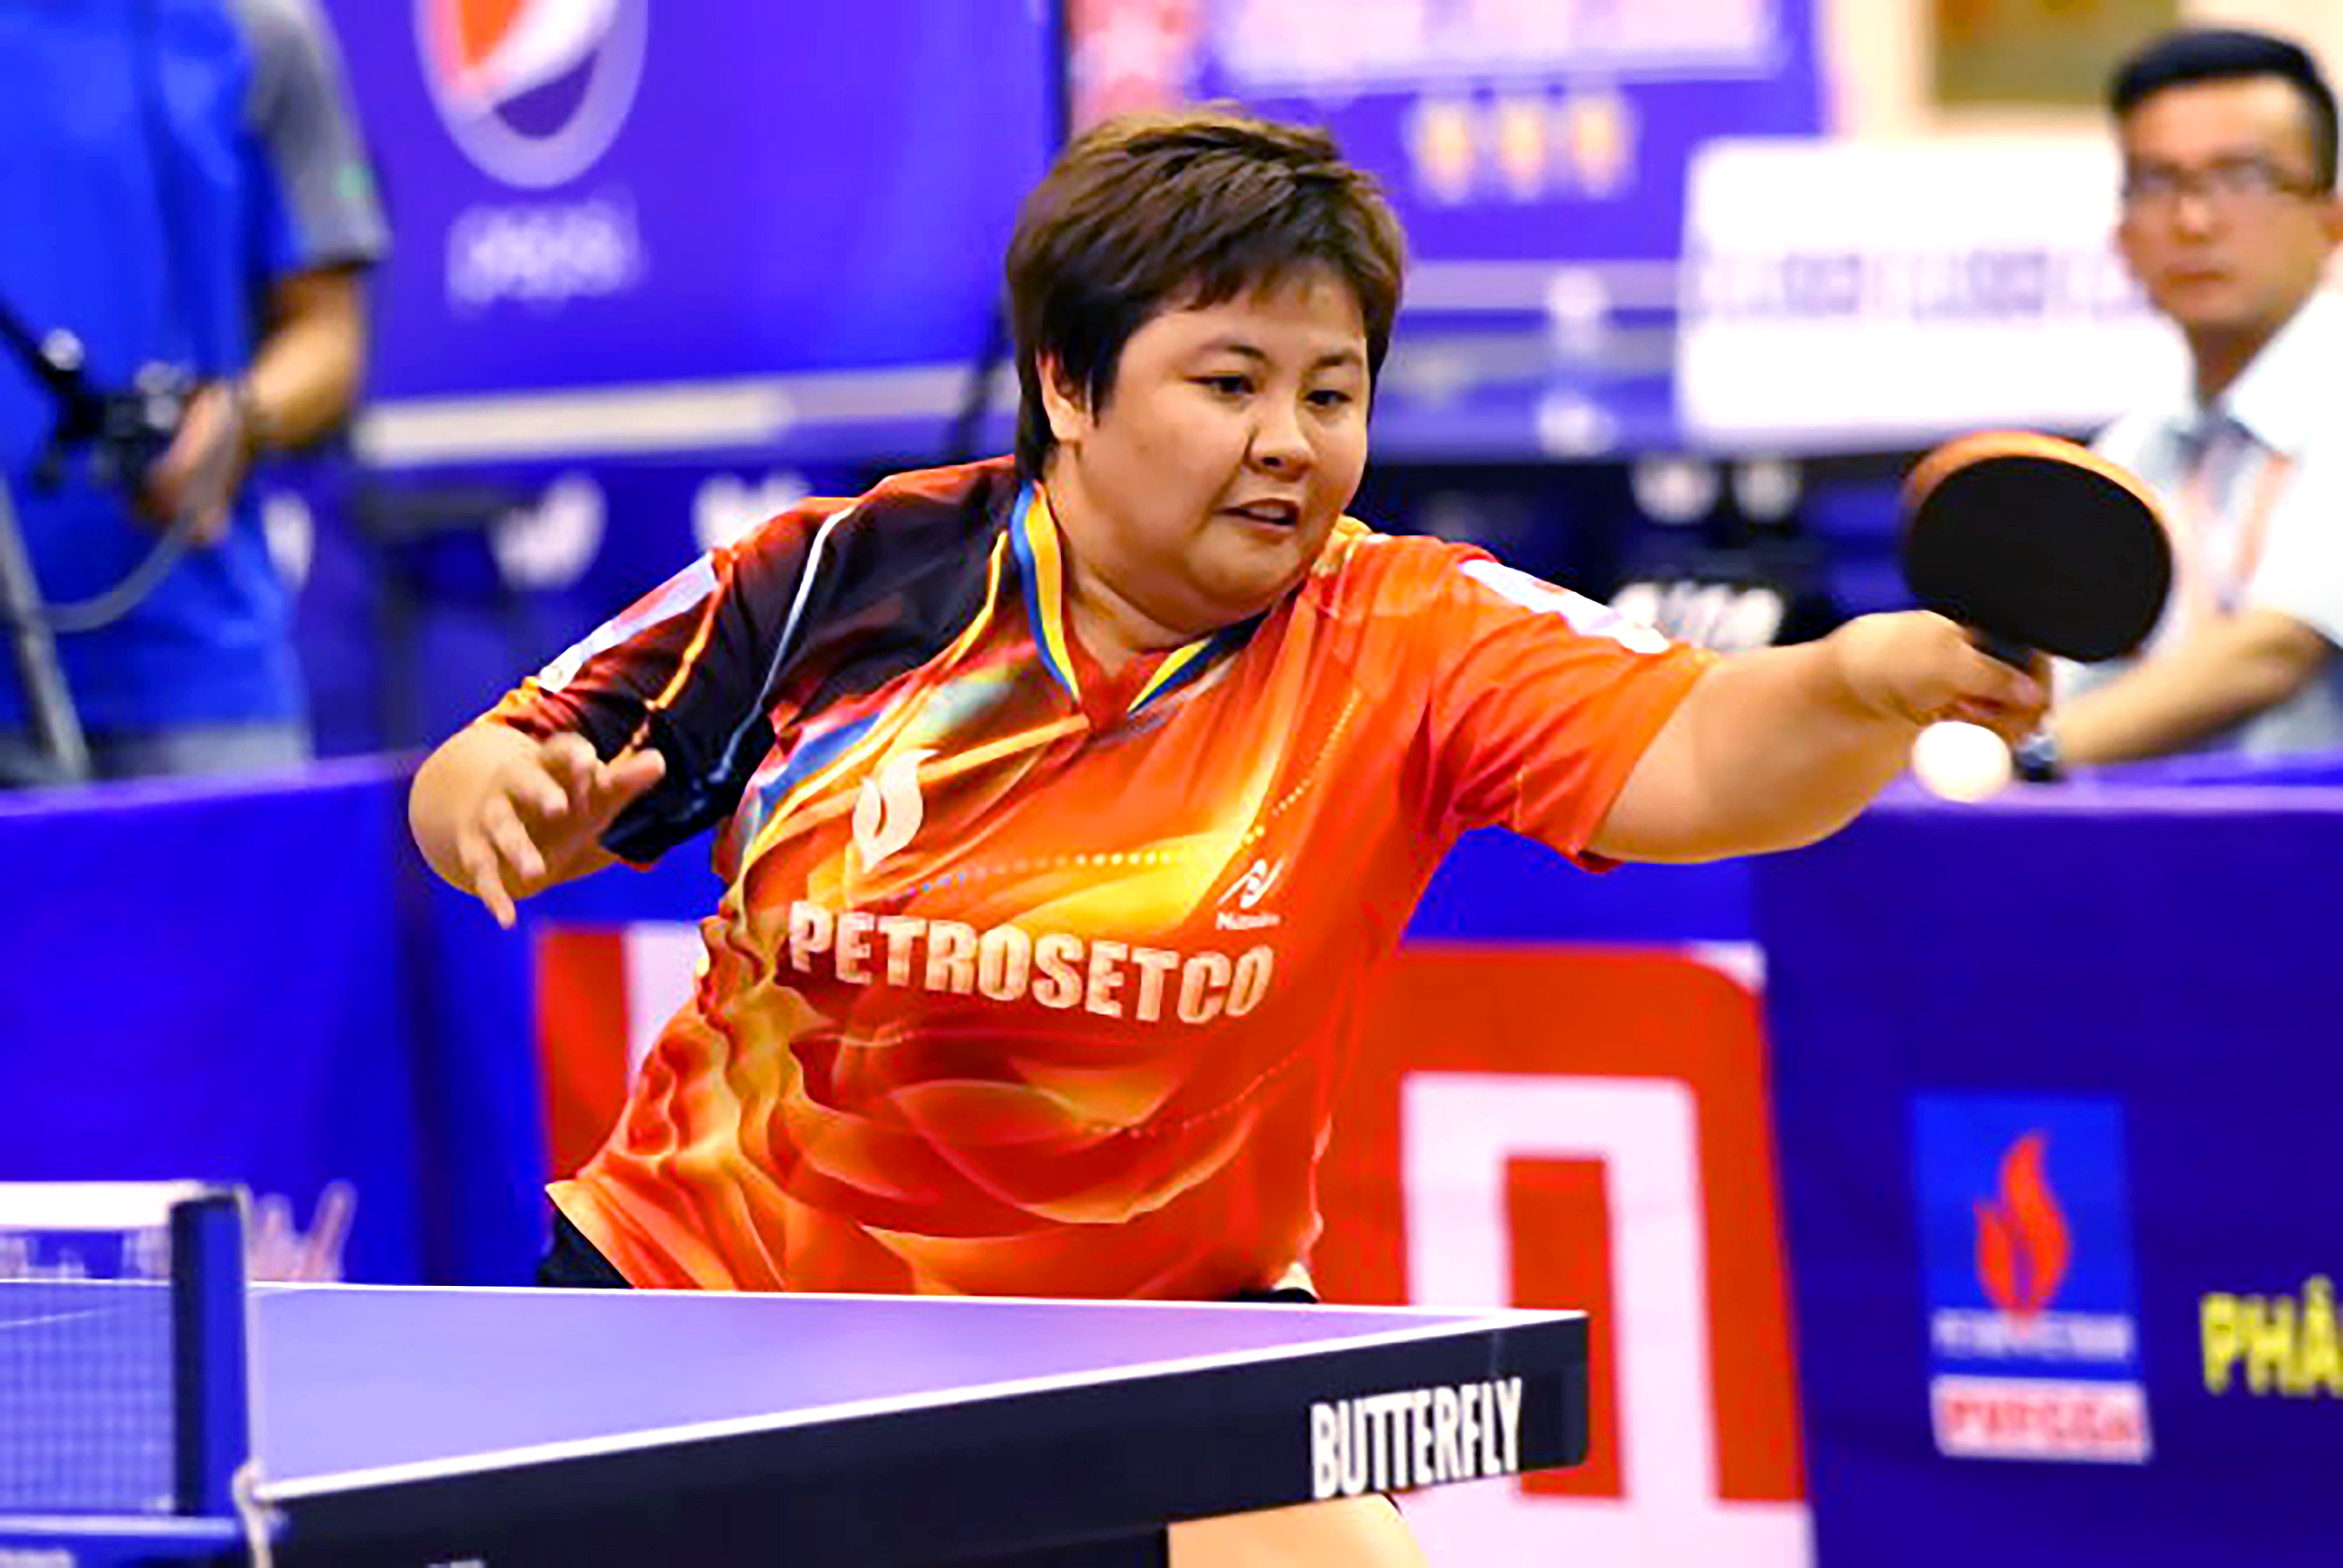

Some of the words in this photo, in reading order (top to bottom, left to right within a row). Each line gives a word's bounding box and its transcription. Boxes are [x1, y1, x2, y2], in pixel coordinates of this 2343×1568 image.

[789, 900, 1273, 1025] PETROSETCO
[2200, 1273, 2343, 1399] PHÂ
[1310, 1376, 1522, 1499] BUTTERFLY
